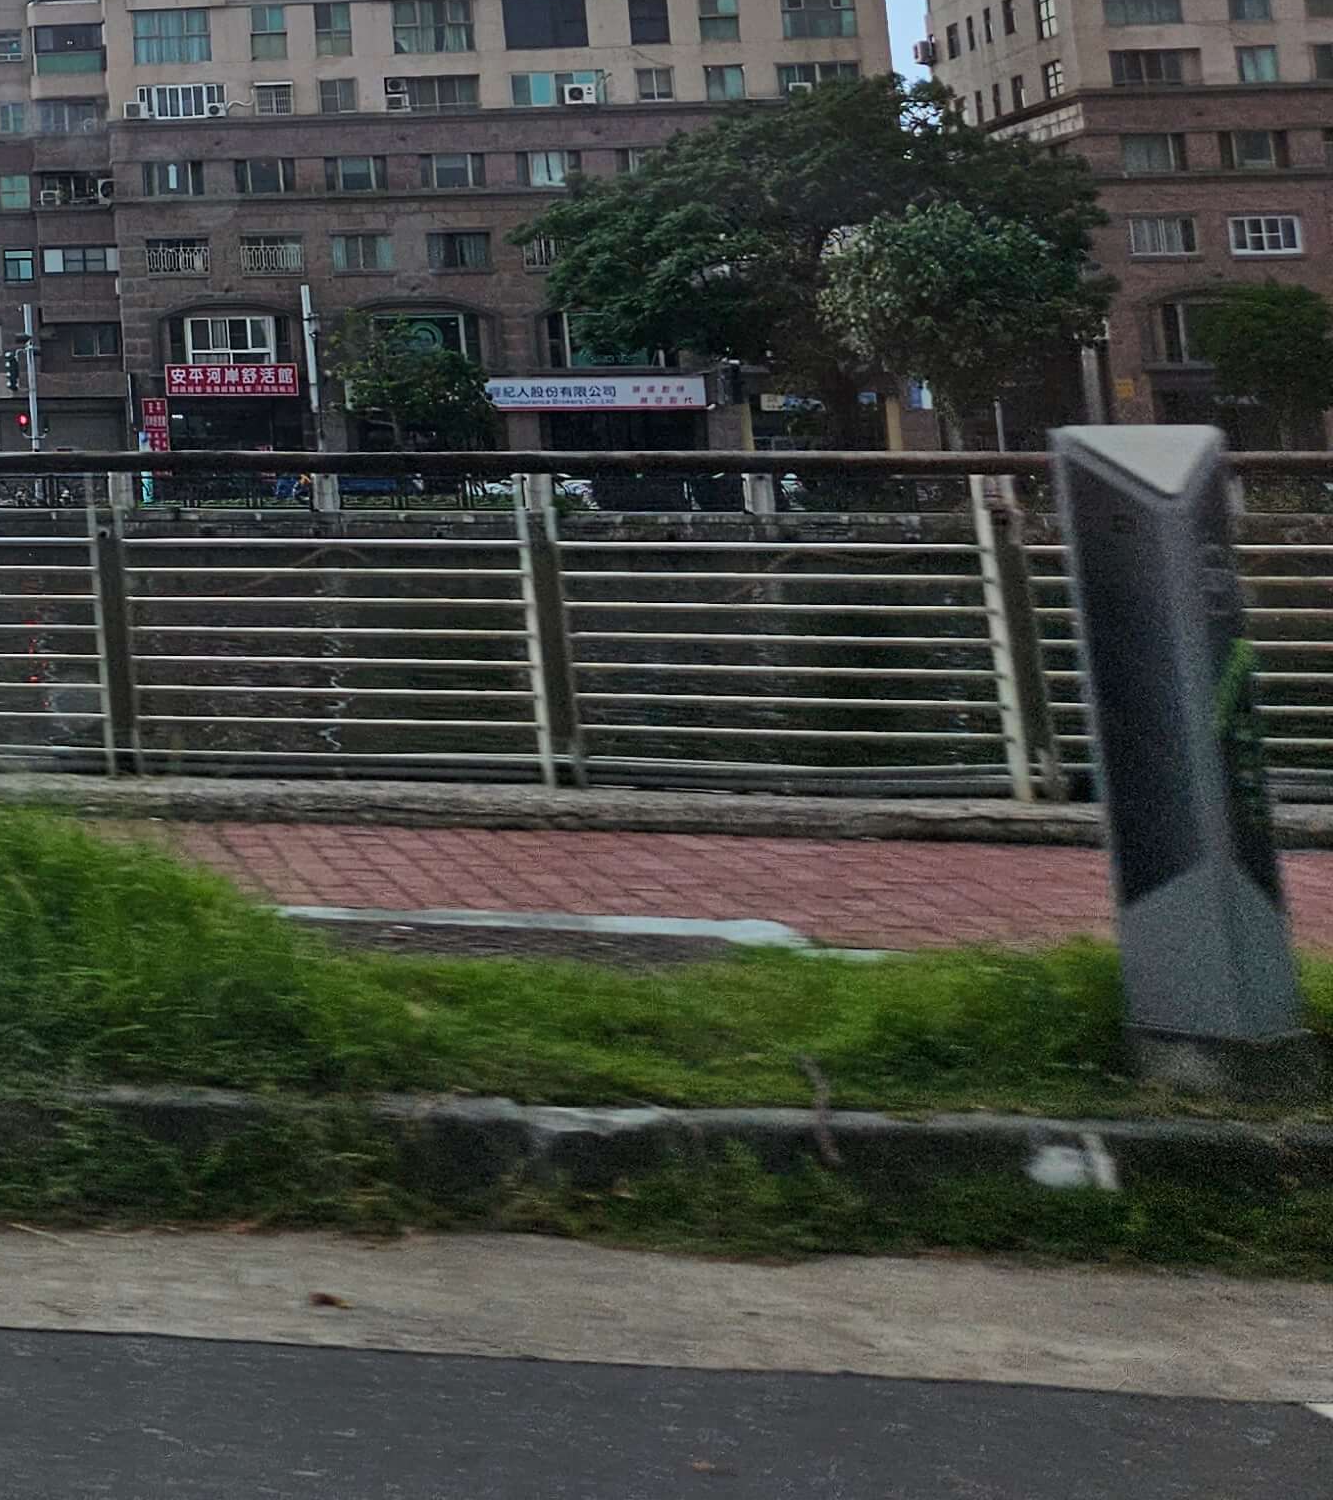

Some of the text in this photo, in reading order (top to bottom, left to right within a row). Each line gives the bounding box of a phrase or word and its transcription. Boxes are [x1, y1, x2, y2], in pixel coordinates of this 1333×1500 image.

[171, 367, 293, 384] 安平河岸舒活館
